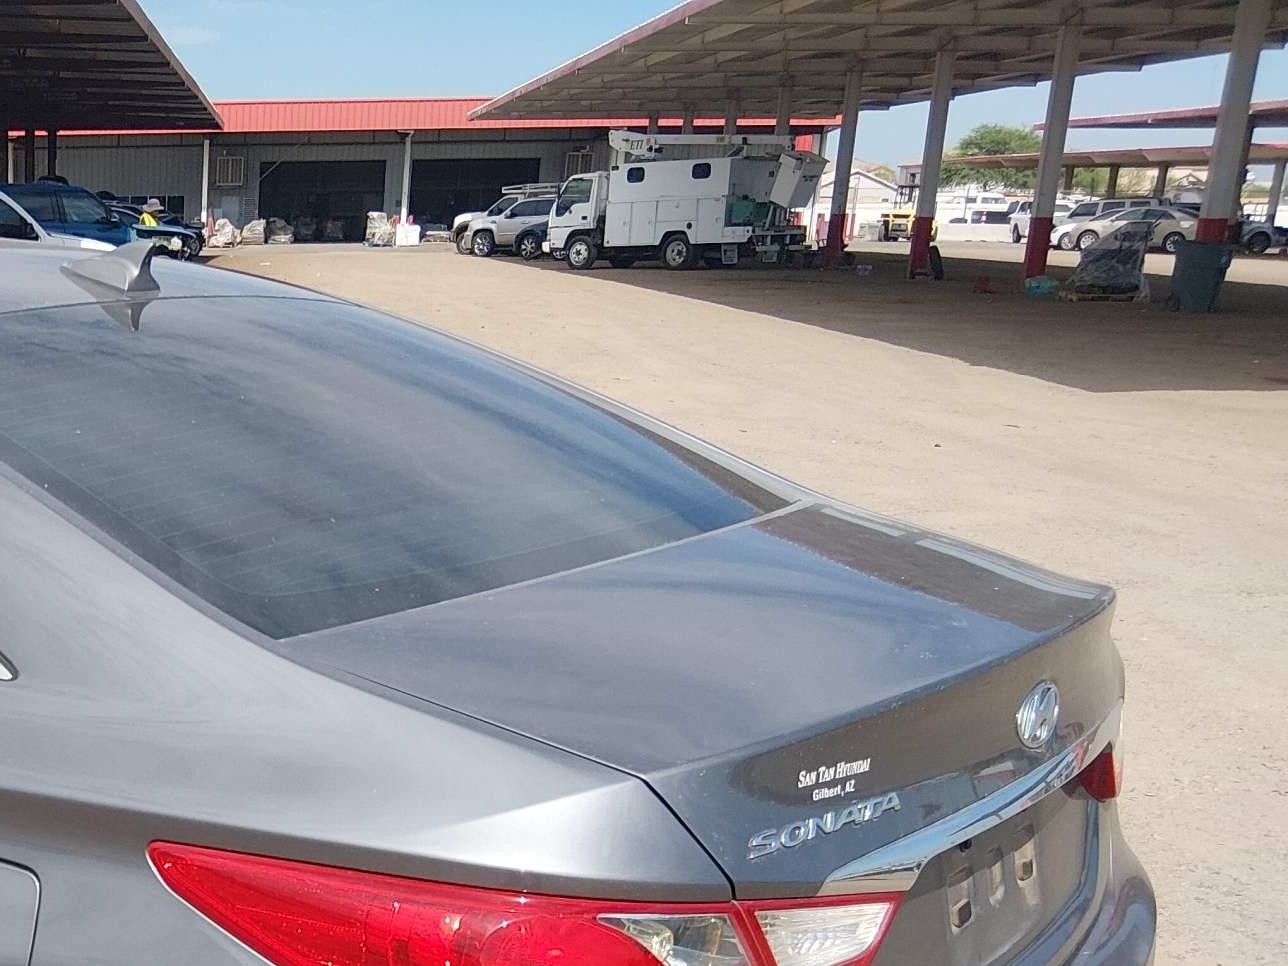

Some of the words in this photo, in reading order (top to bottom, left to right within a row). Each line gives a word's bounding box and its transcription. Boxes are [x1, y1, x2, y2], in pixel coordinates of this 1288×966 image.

[812, 784, 845, 801] Gilbert,
[844, 779, 856, 793] AZ
[746, 792, 902, 861] SONATA
